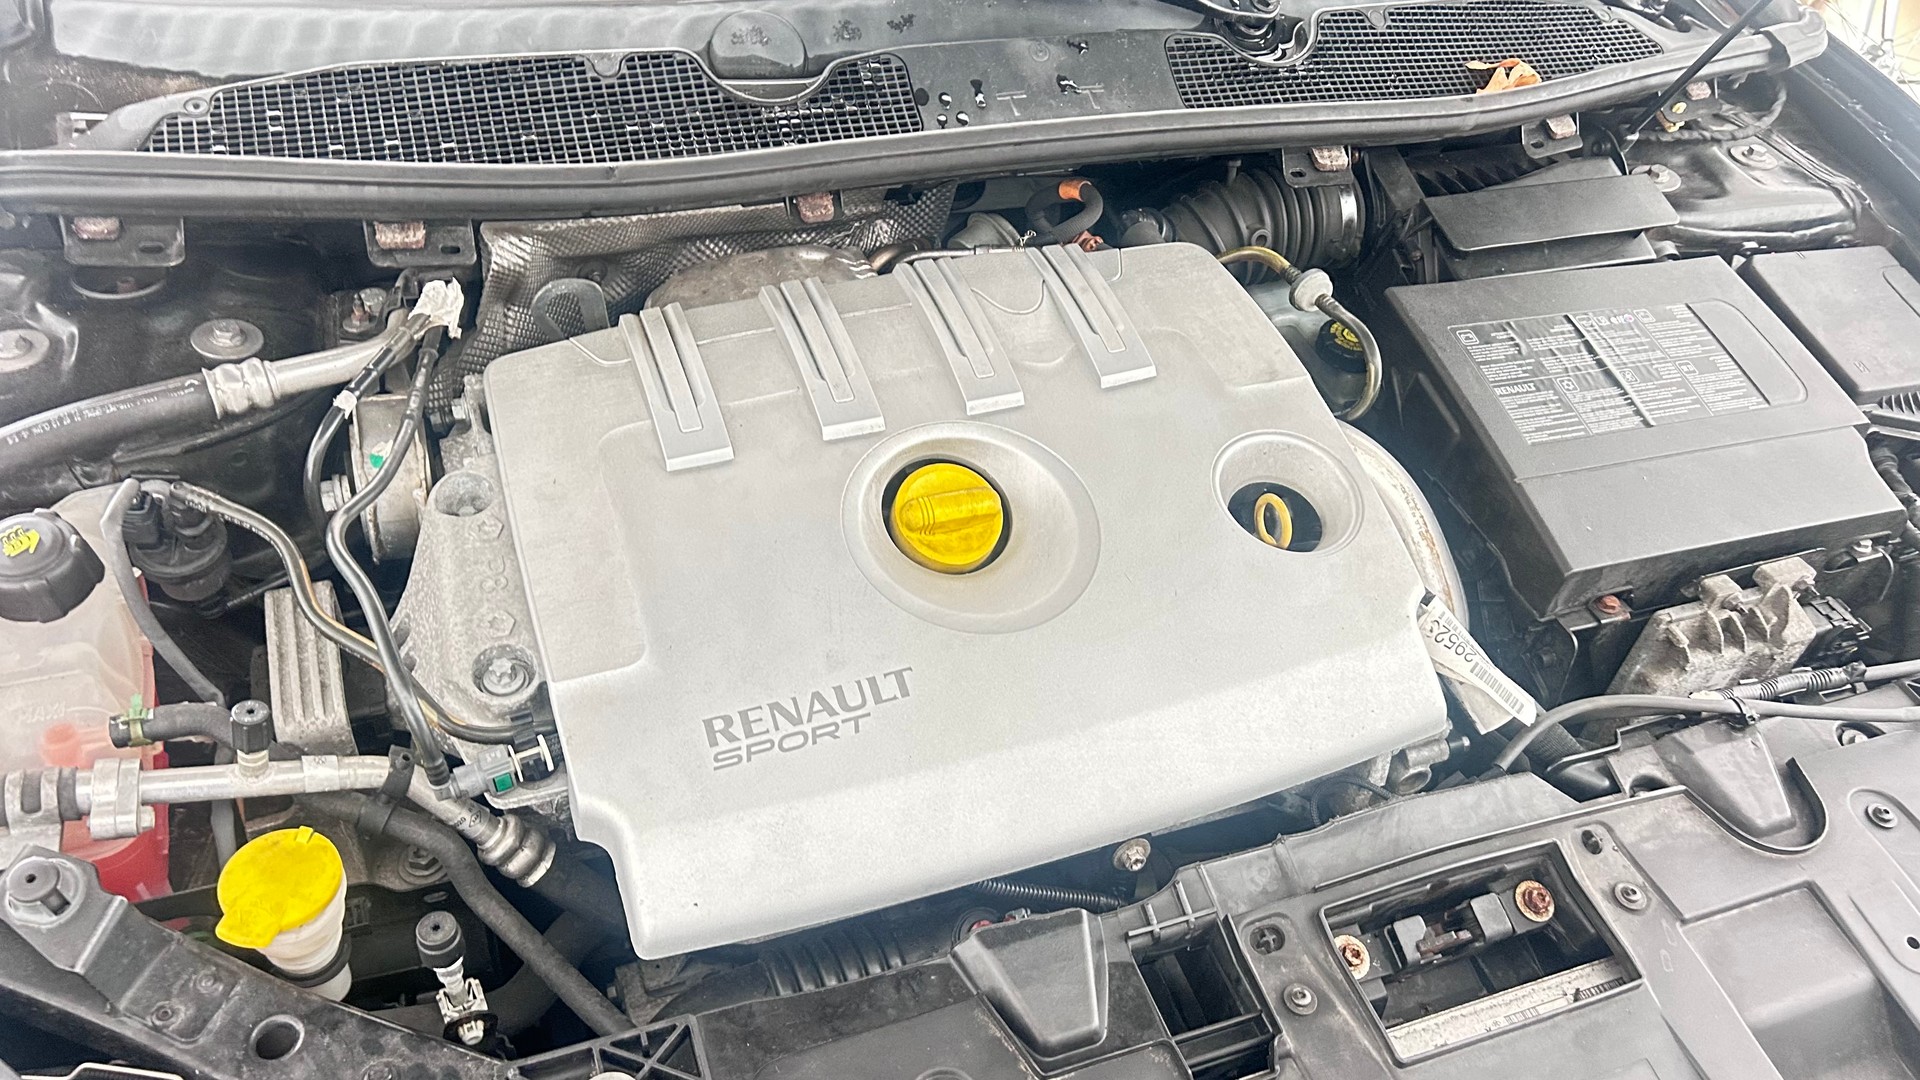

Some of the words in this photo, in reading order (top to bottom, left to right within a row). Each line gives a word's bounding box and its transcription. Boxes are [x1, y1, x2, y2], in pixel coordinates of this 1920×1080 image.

[1494, 383, 1536, 395] RENAULT
[702, 667, 913, 748] RENAULT
[713, 712, 871, 771] SPORT
